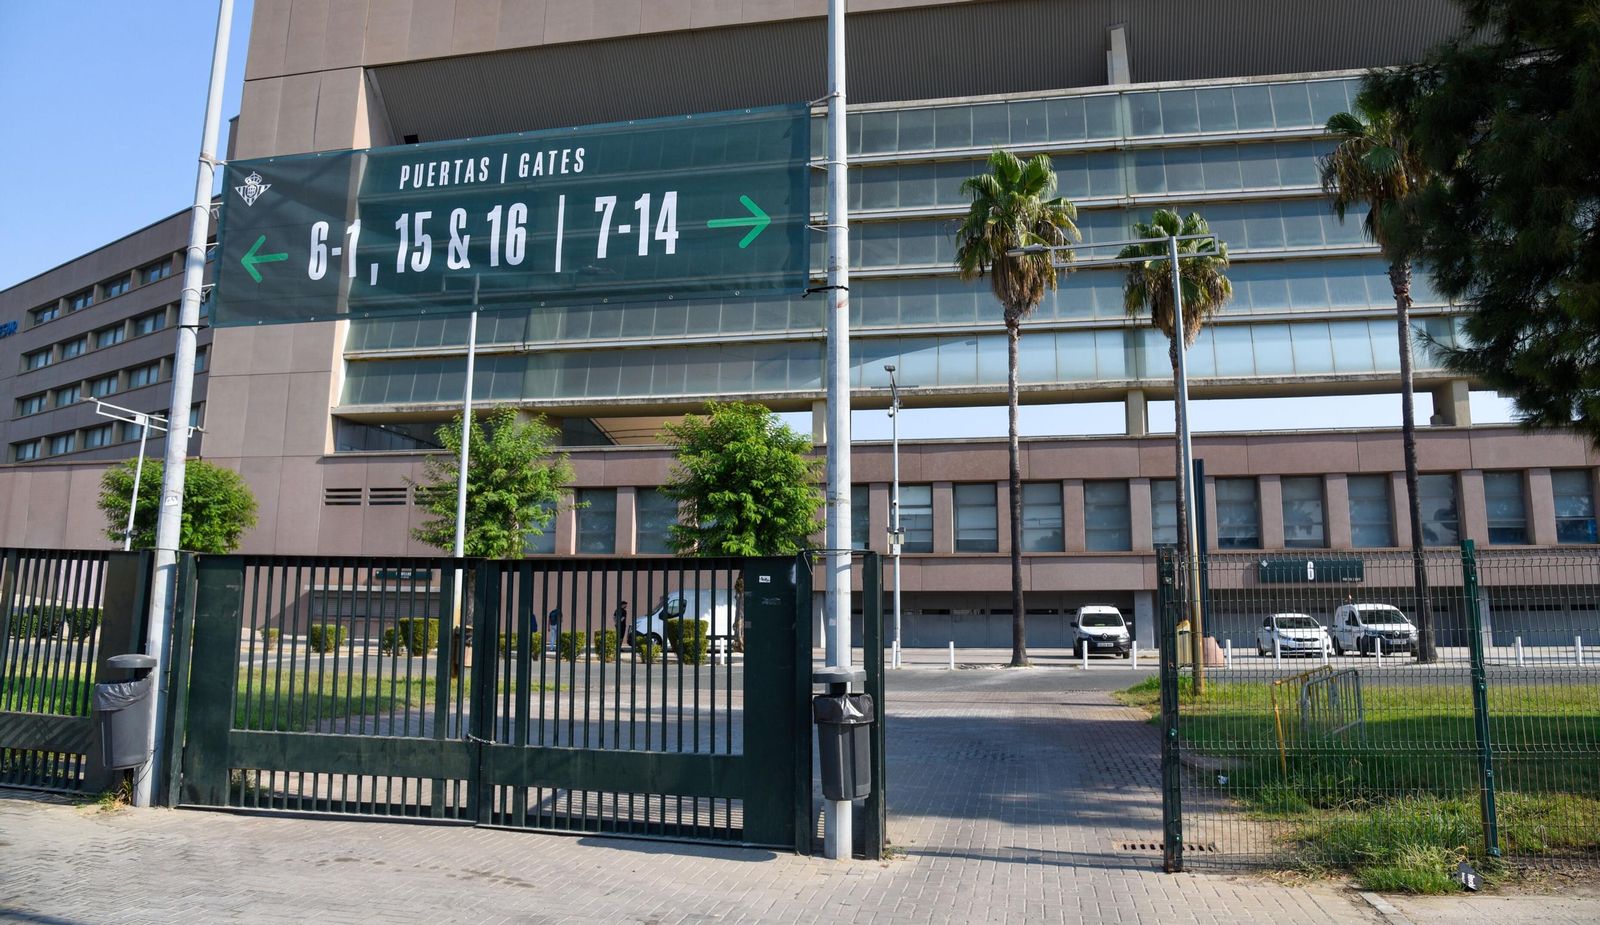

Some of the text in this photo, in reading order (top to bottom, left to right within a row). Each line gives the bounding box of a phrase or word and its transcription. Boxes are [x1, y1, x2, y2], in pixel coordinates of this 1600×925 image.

[399, 157, 490, 190] PUERTAS
[518, 147, 585, 178] GATES
[308, 218, 379, 286] 6-1,
[395, 211, 432, 274] 15
[447, 207, 471, 270] &
[487, 202, 528, 267] 16
[594, 191, 679, 259] 7-14
[1307, 561, 1315, 580] 6
